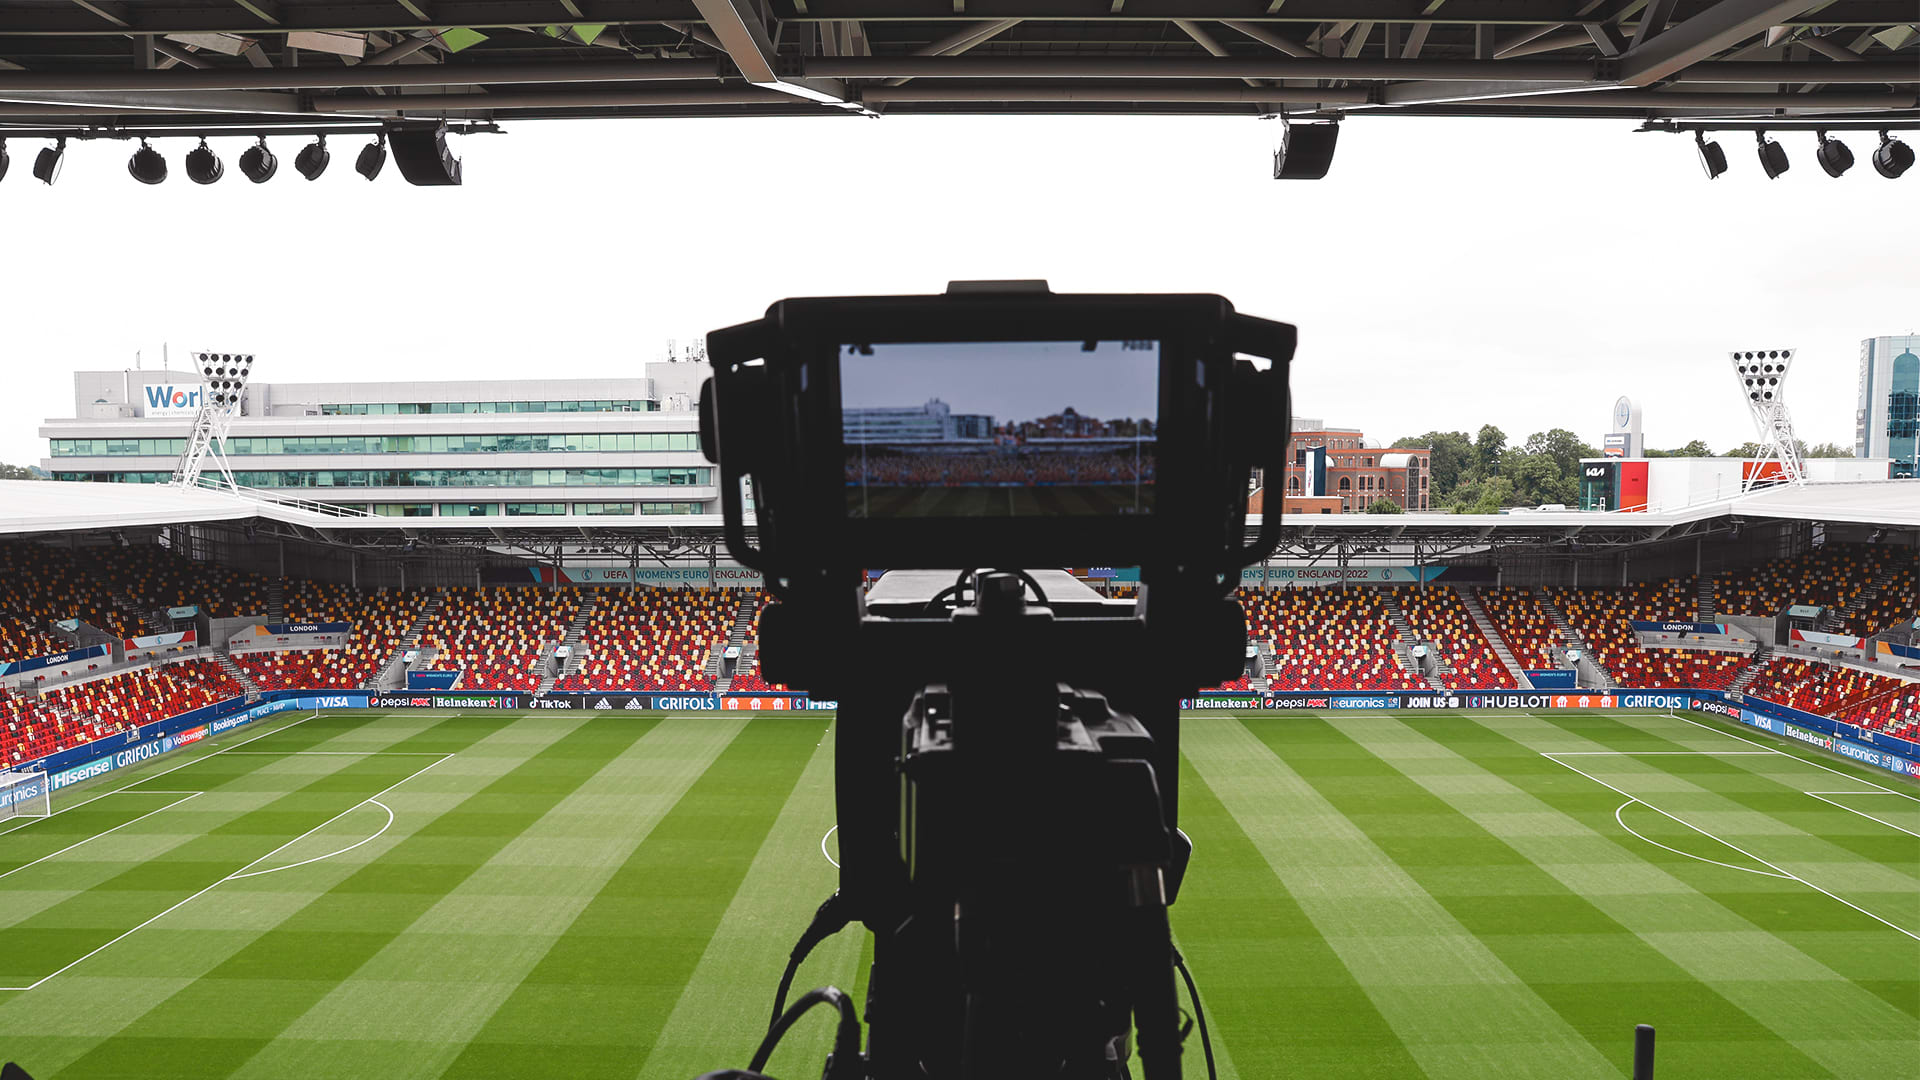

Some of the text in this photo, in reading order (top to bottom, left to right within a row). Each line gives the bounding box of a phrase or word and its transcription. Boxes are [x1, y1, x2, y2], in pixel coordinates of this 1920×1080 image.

[145, 386, 218, 409] Worl
[603, 569, 761, 579] UEFA WOMEN'S EURO ENGLAND
[1242, 569, 1369, 579] EN'S EURO ENGLAND 2022
[289, 624, 318, 633] LONDON
[1662, 623, 1694, 632] LONDON
[46, 654, 69, 665] LONDON
[320, 696, 350, 708] VISA
[380, 696, 409, 709] pepsi
[436, 696, 488, 708] Heineken
[540, 700, 572, 709] TikTok
[658, 697, 715, 710] GRIFOLS
[1195, 698, 1249, 709] Heineken
[1275, 698, 1306, 710] pepsi
[1339, 698, 1385, 709] euronics
[1407, 696, 1431, 708] JOIN
[1433, 696, 1447, 708] US
[1484, 695, 1550, 708] HUBLOT
[1624, 695, 1682, 709] GRIFOLS
[1702, 701, 1727, 715] pepsi
[213, 713, 249, 732] Booking.com
[1753, 714, 1772, 731] VISA
[173, 727, 209, 747] Volkswagen
[1786, 725, 1825, 747] Heineken
[116, 740, 160, 768] GRIFOLS
[1840, 744, 1879, 765] euronics
[54, 760, 110, 790] Hisense
[1905, 762, 1920, 776] Vol
[0, 784, 38, 808] uronics
